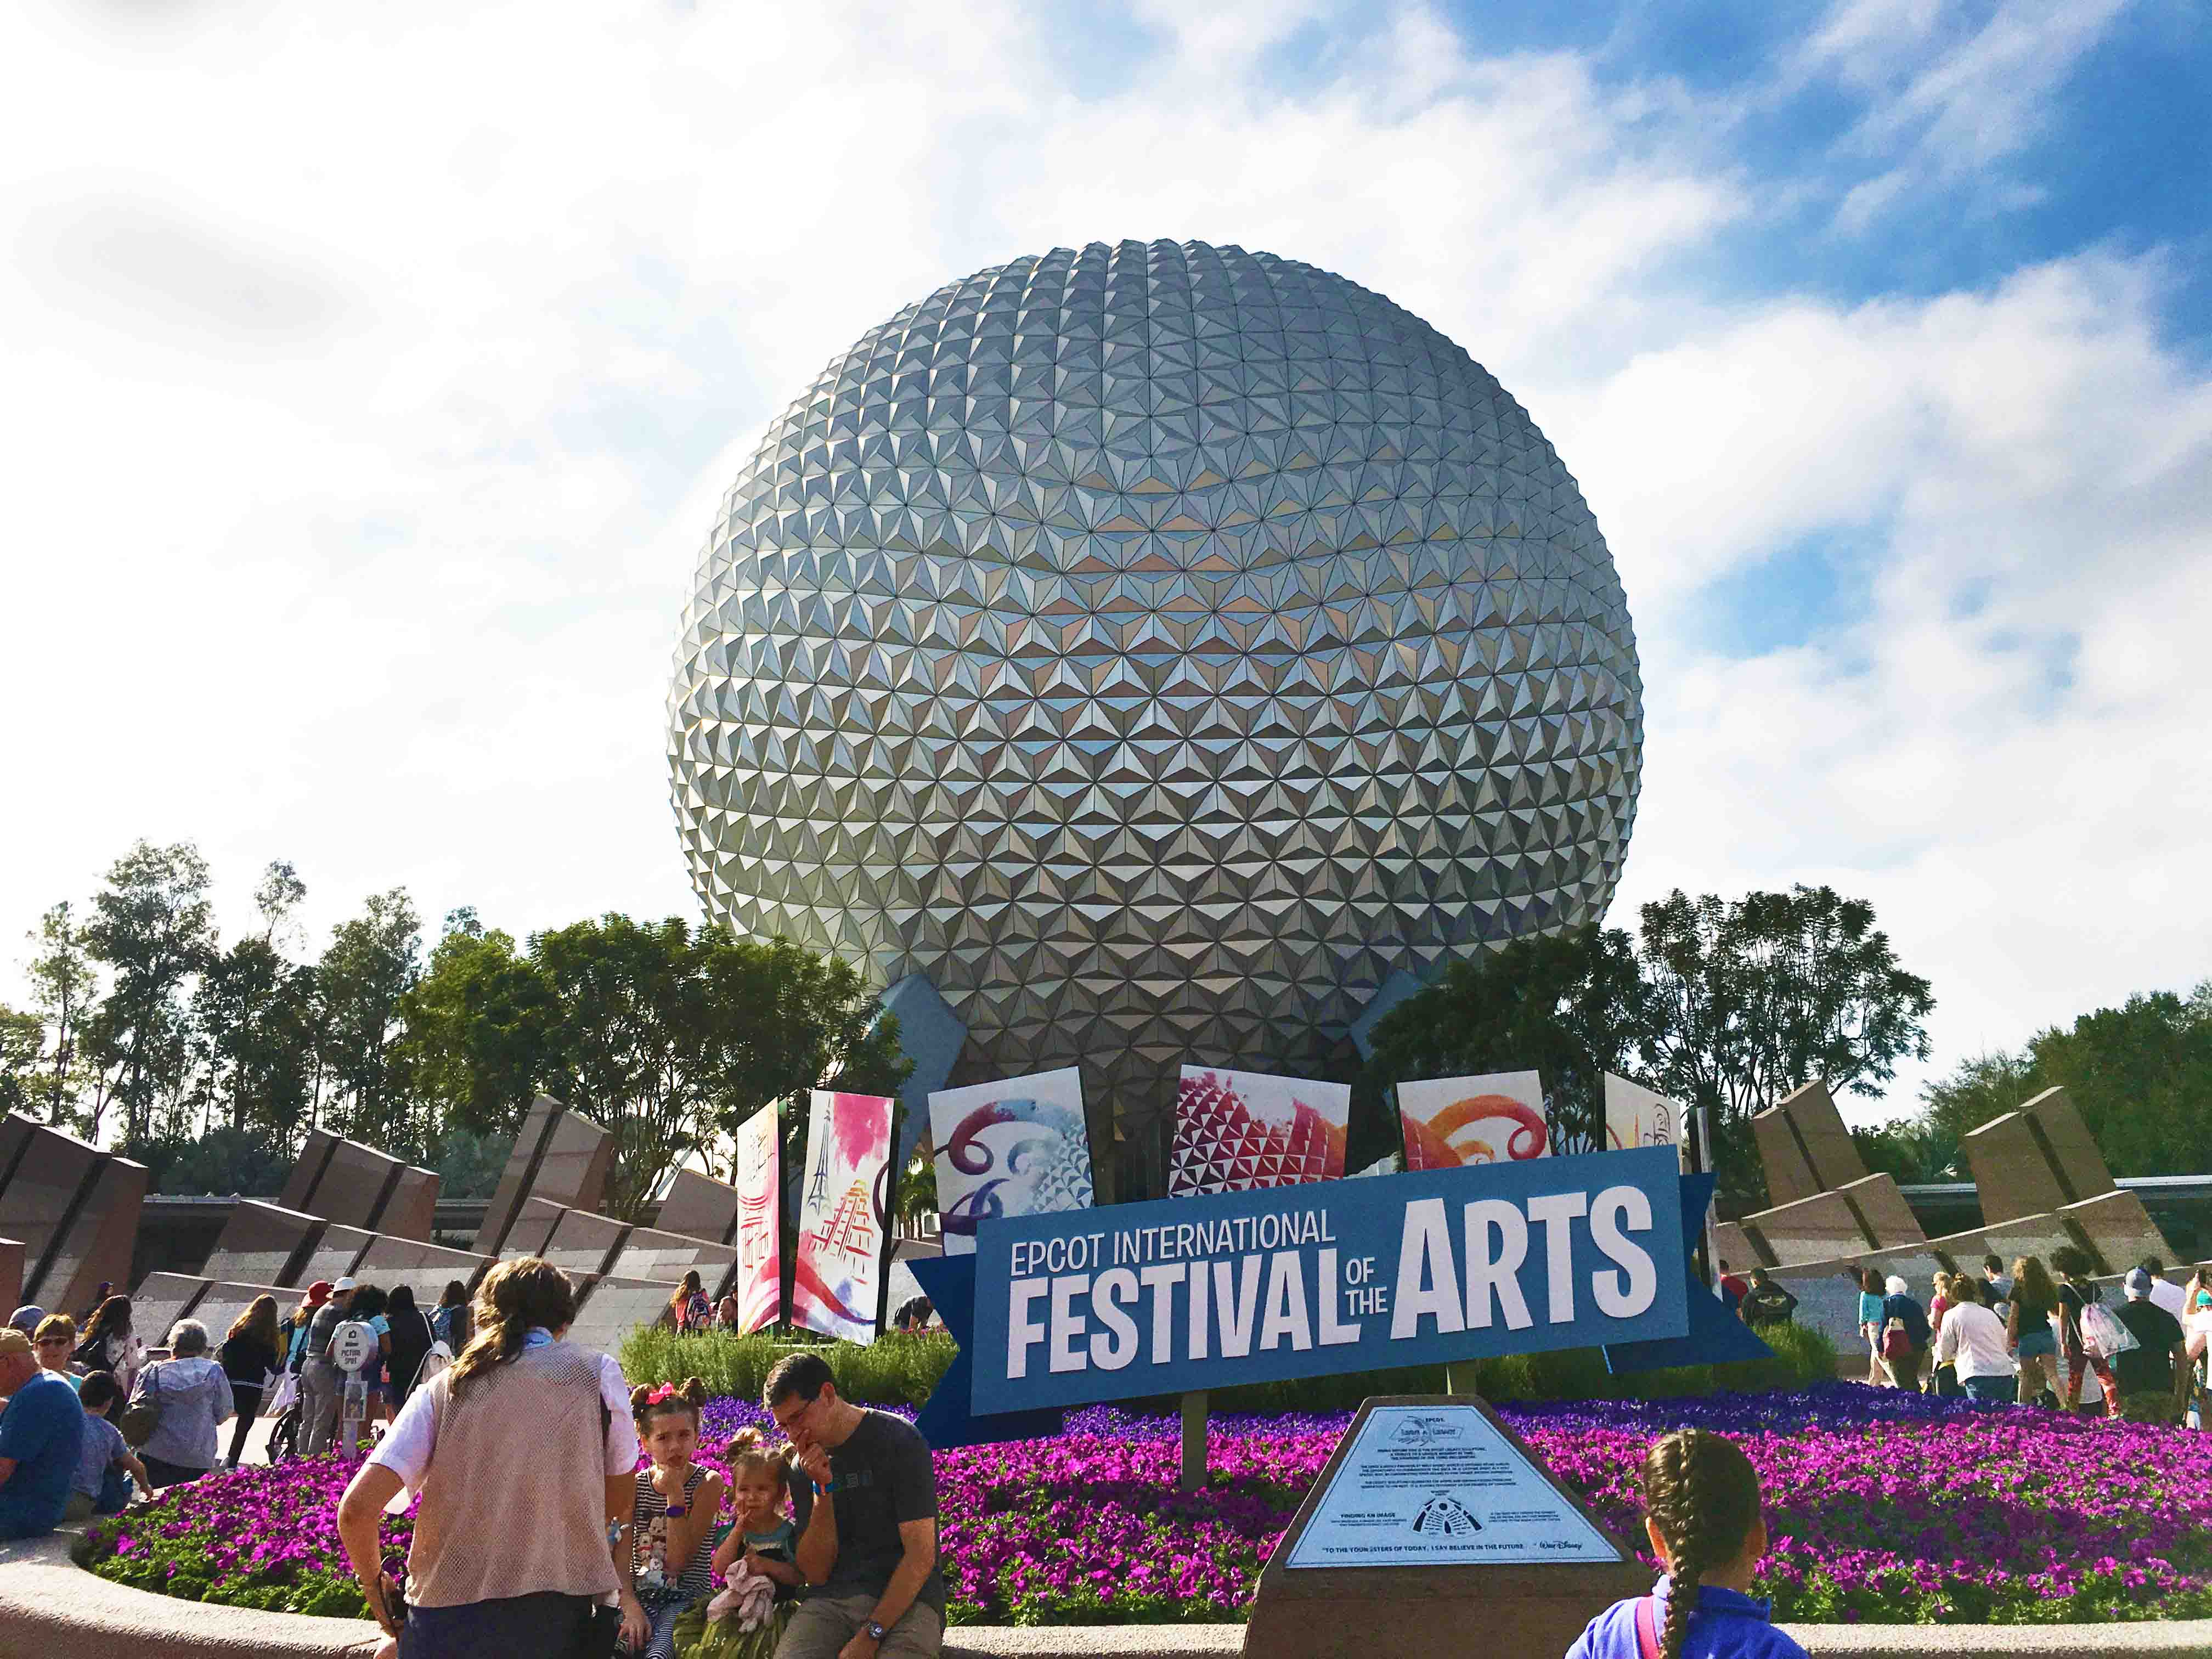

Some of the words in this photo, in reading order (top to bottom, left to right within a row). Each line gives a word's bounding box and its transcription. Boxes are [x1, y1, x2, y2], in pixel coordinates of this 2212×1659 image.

[1012, 1233, 1105, 1276] EPCOT
[1114, 1209, 1336, 1265] INTERNATIONAL
[1346, 1257, 1375, 1284] OF
[1390, 1186, 1656, 1339] ARTS
[1007, 1248, 1361, 1379] FESTIVAL
[1345, 1286, 1387, 1316] THE
